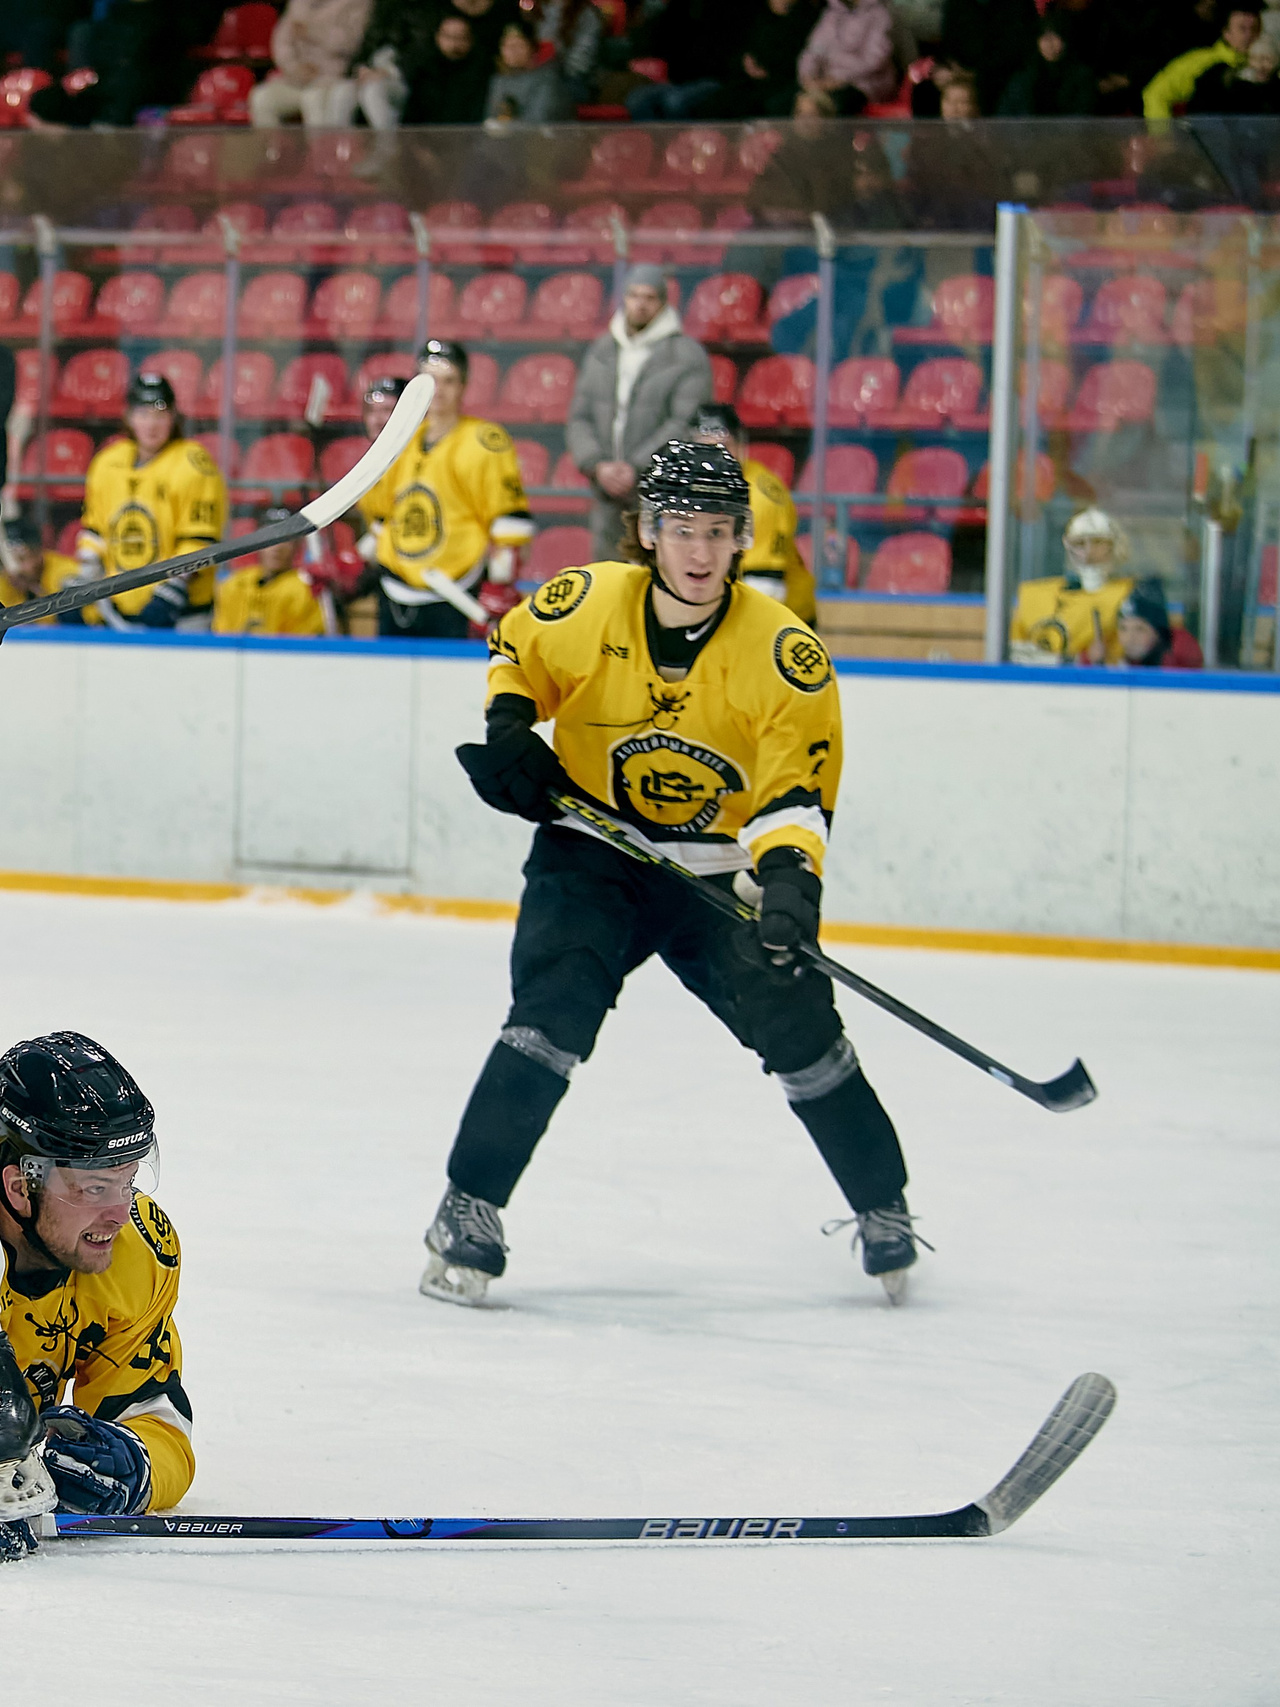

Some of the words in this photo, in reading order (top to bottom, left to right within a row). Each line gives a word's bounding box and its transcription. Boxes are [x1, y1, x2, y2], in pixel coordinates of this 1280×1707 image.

[107, 1131, 143, 1149] SOYUZ
[177, 1522, 243, 1534] BAUER
[638, 1518, 805, 1540] BAUER
